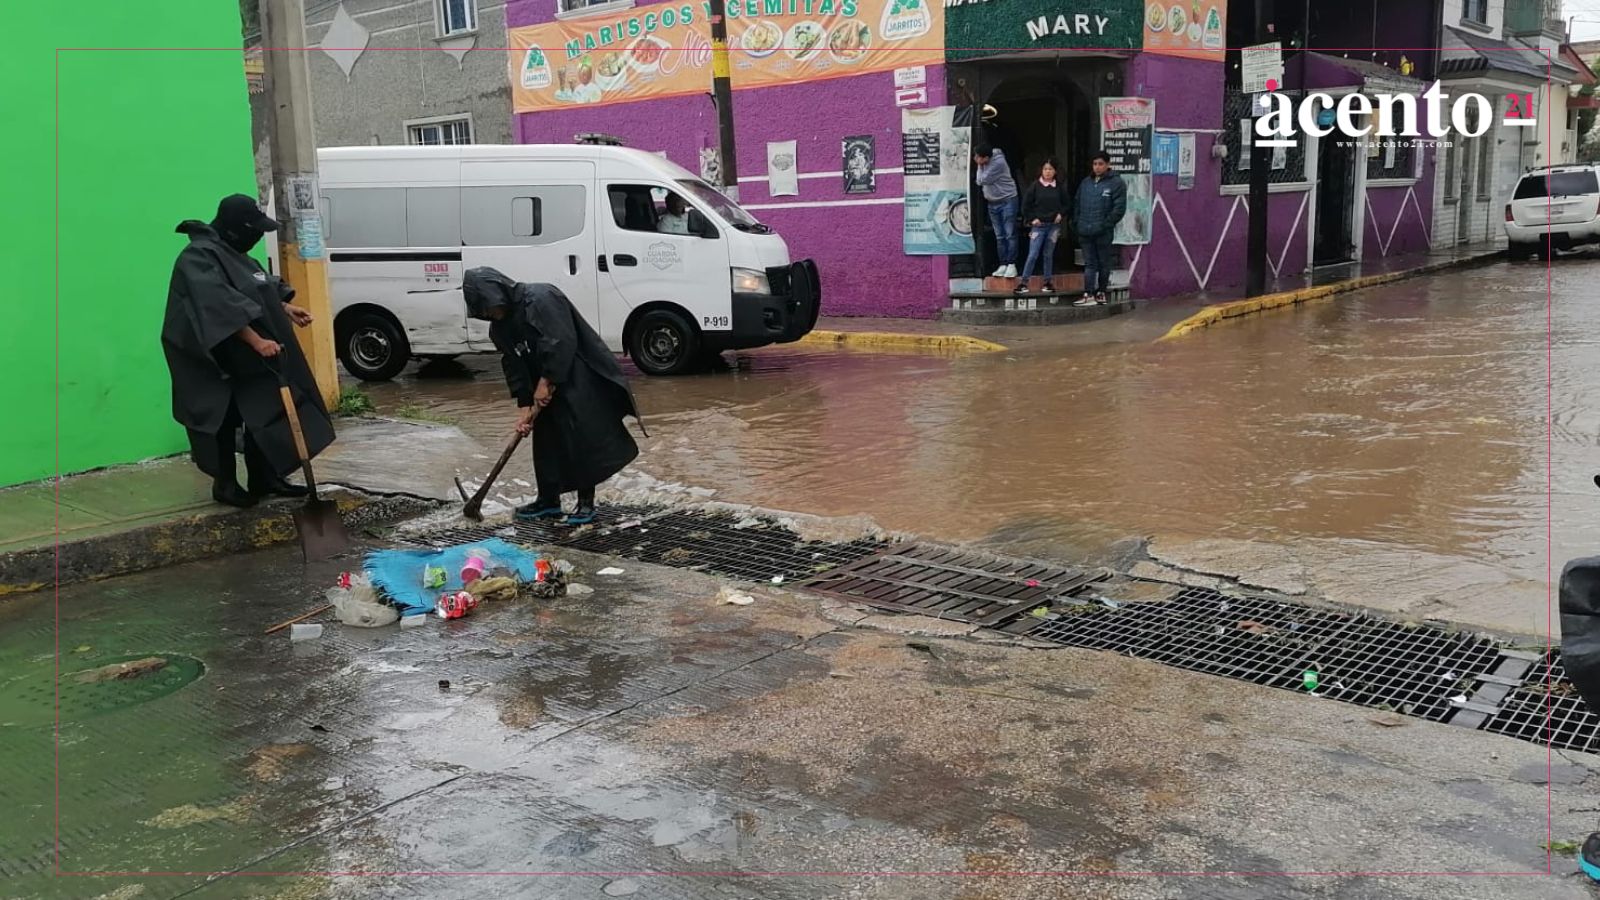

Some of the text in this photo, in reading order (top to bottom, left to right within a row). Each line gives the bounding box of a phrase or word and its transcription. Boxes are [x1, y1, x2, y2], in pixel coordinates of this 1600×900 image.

[565, 5, 694, 60] MARISCOS
[727, 0, 859, 18] CEMITAS
[887, 18, 923, 32] JARRITOS
[1026, 13, 1109, 41] MARY
[703, 316, 729, 327] P-919
